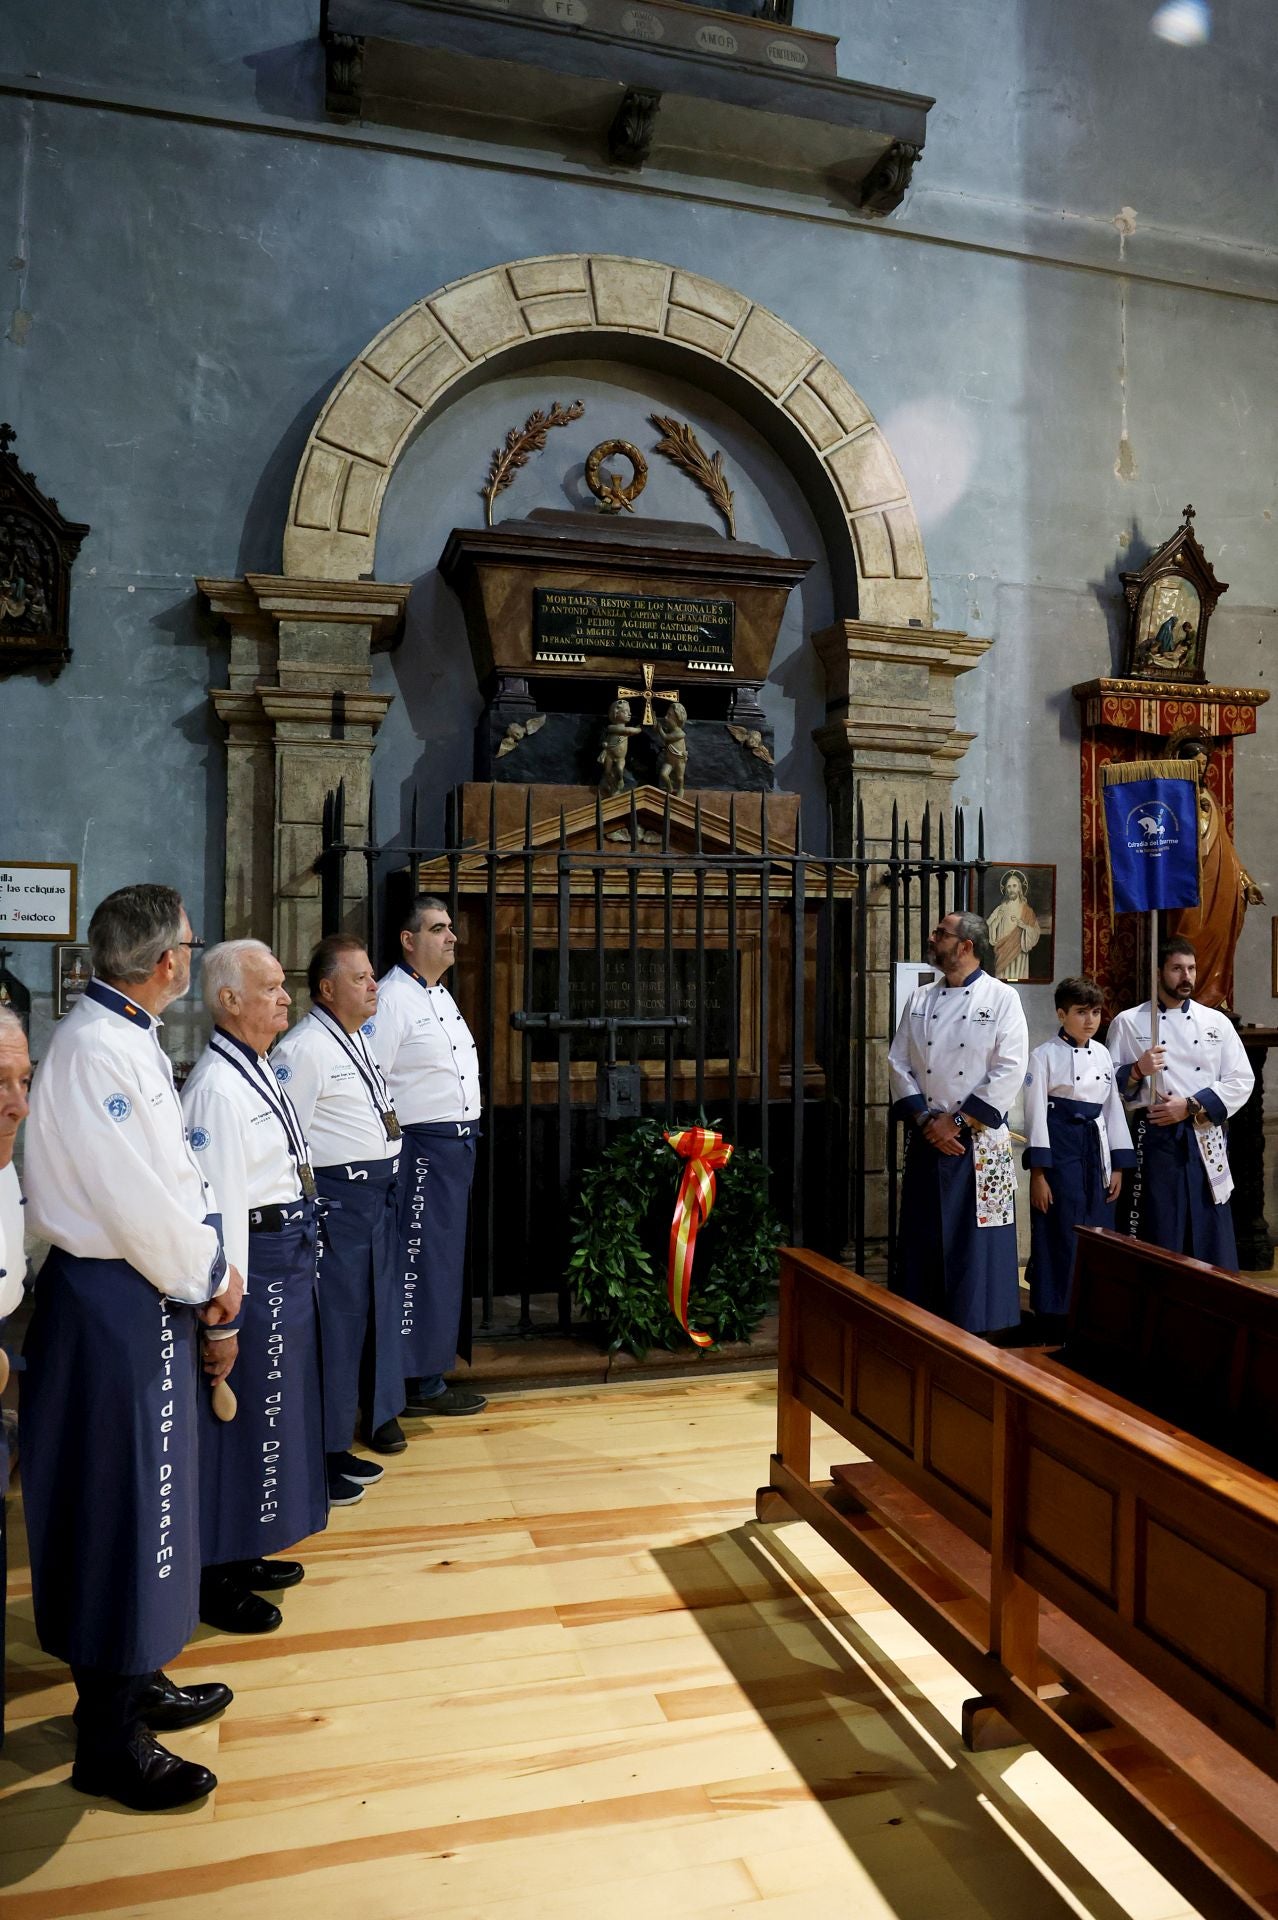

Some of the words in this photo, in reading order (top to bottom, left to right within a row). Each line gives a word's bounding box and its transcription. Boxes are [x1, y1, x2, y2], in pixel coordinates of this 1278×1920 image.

[700, 31, 735, 49] AMOR
[768, 47, 806, 64] PENITENCIA
[546, 594, 597, 606] MORTALES
[600, 598, 630, 609] RESTOS
[634, 601, 645, 609] DE
[667, 602, 723, 615] NACIONALES
[550, 606, 588, 616] ANTONIO
[586, 627, 617, 637] MIGUEL
[587, 618, 615, 626] PEDRO
[622, 620, 657, 629] AGUIRRE
[618, 639, 658, 650] NACIONAL
[662, 642, 672, 651] DE
[407, 1238, 421, 1263] del
[400, 1272, 418, 1335] Desarme
[264, 1391, 281, 1427] del
[160, 1400, 173, 1453] del
[260, 1440, 280, 1523] Desarme
[156, 1464, 173, 1580] Desarme
